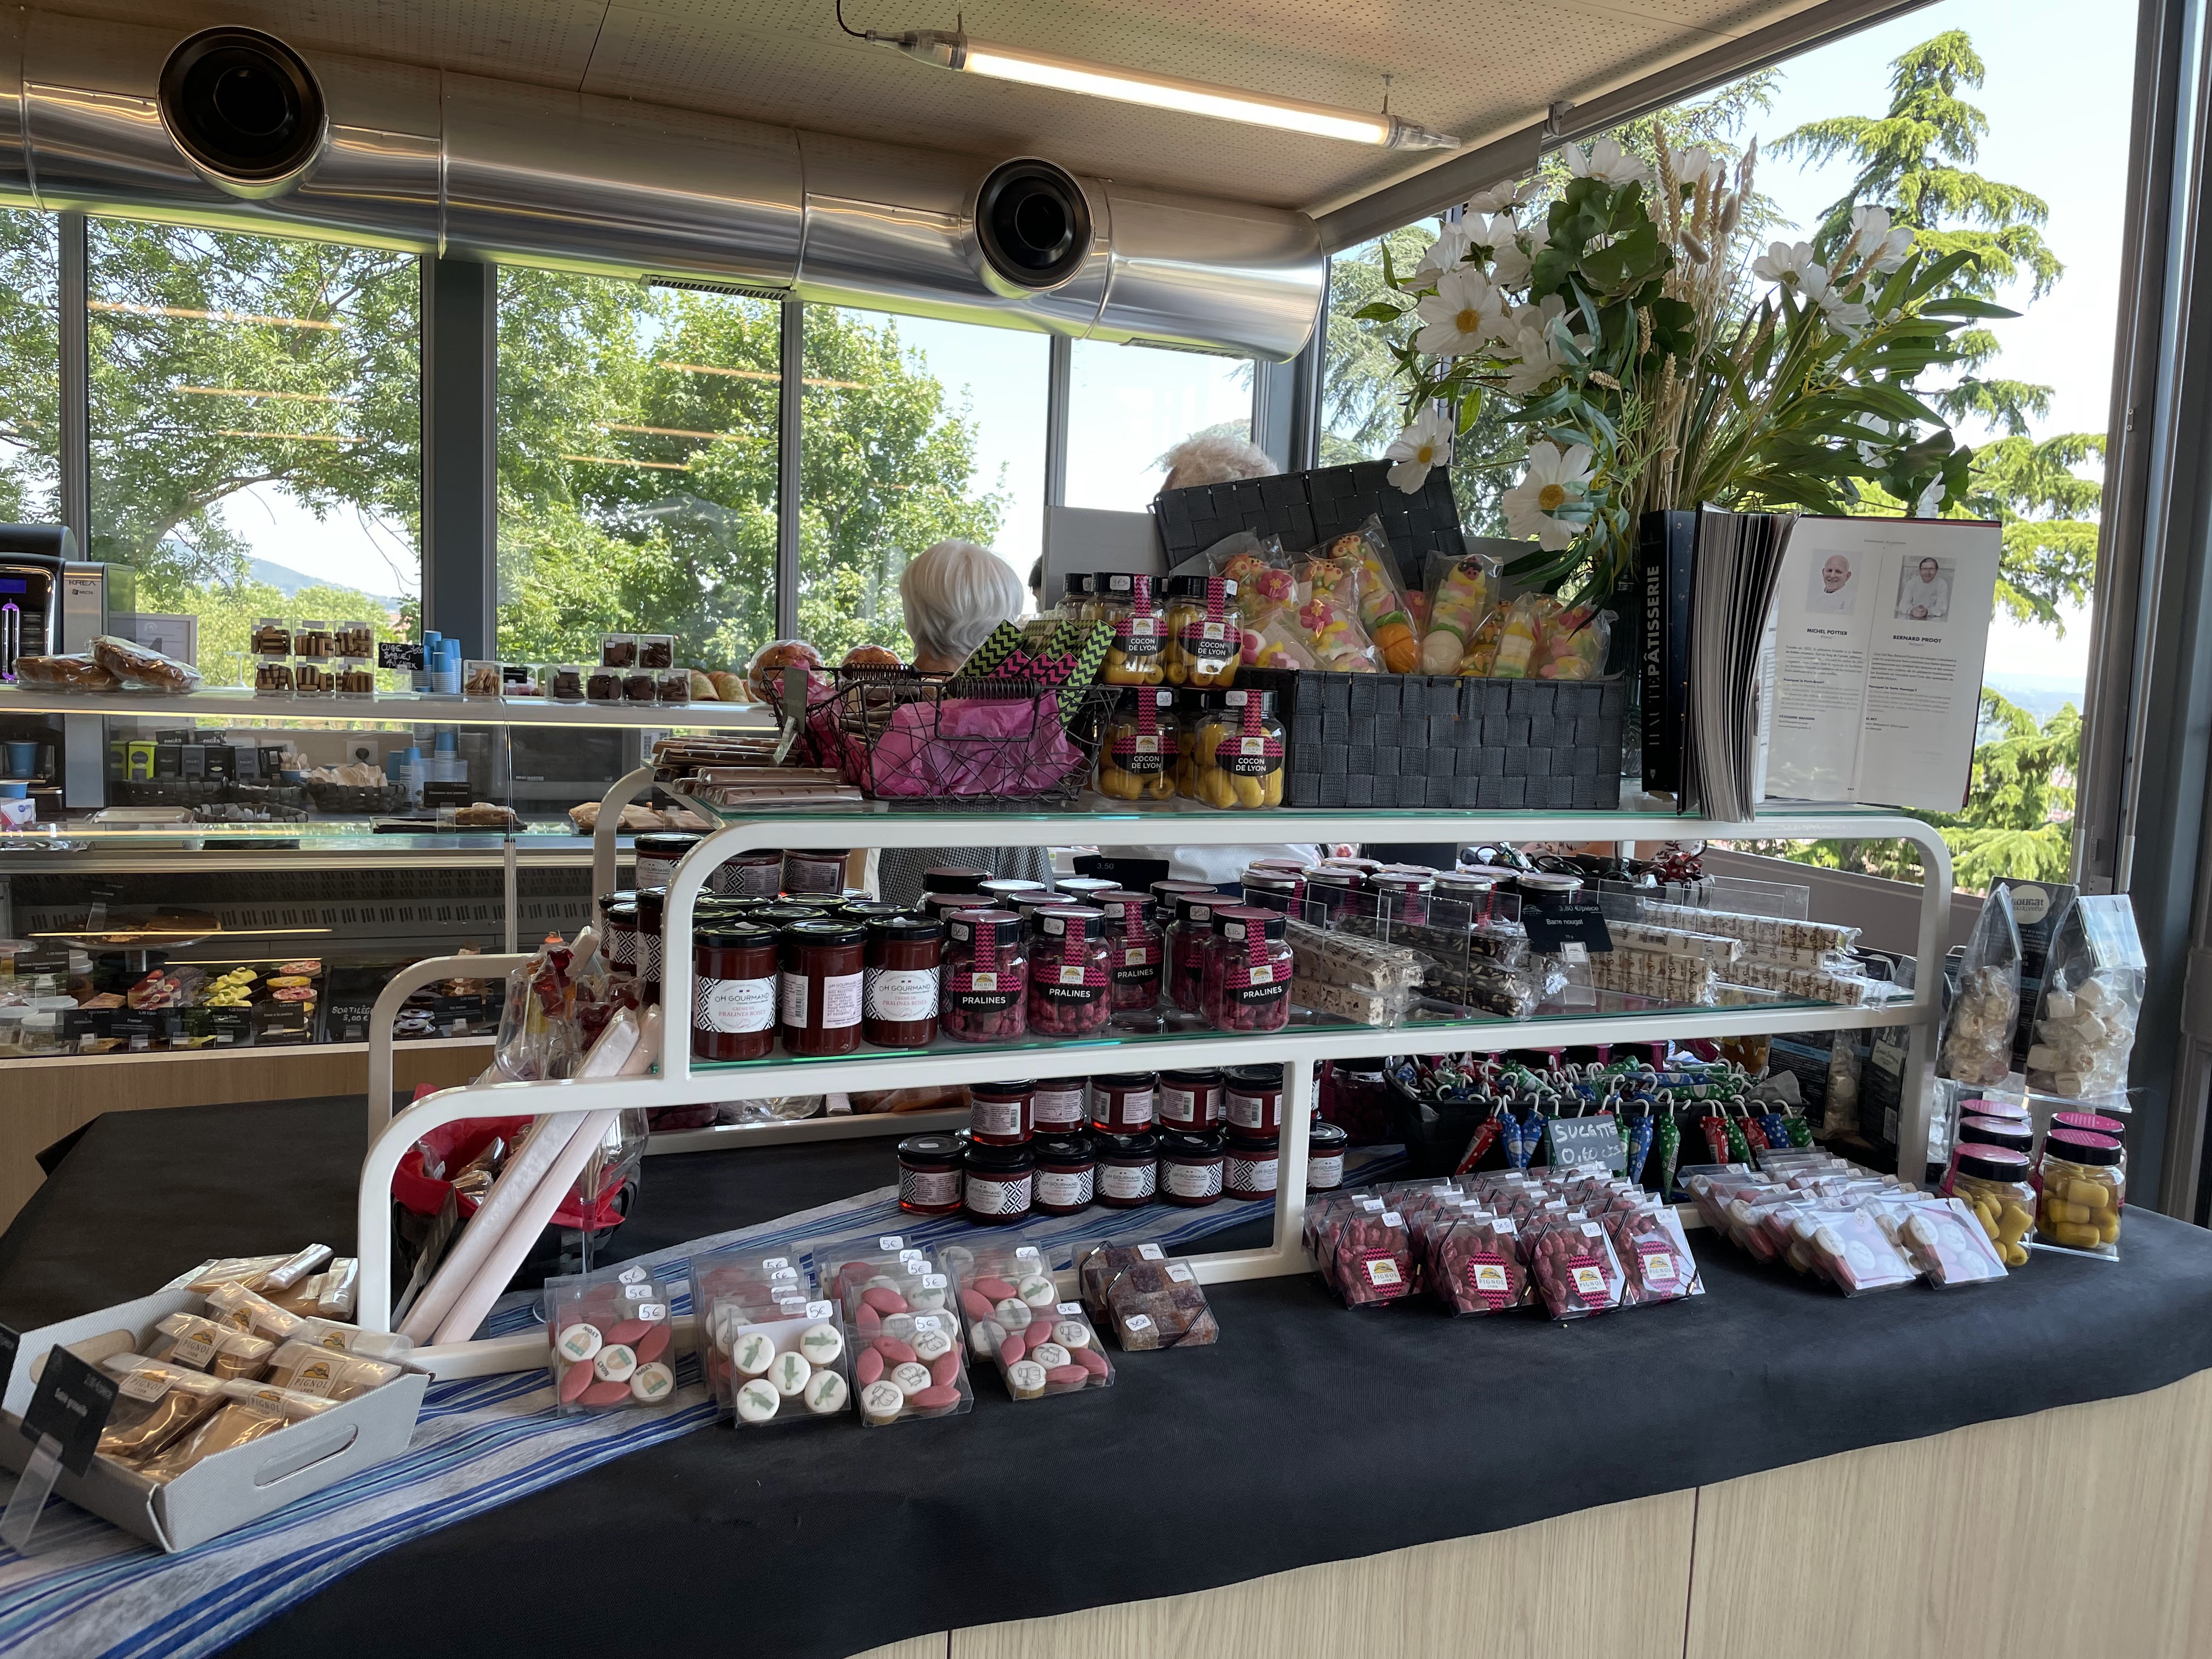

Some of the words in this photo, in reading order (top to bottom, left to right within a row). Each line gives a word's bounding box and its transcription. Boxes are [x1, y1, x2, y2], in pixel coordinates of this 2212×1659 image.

[1643, 566, 1660, 676] PÂTISSERIE
[1118, 968, 1154, 978] PRALINES
[729, 992, 769, 1002] GOURMAND
[1049, 989, 1091, 998] PRALINES
[1243, 985, 1283, 999] PRALINES
[962, 996, 1006, 1005] PRALINES
[1384, 1216, 1401, 1224] 3€50
[883, 1239, 897, 1249] 5€
[911, 1265, 926, 1274] 5€
[624, 1271, 639, 1284] 5€
[925, 1278, 940, 1286] 5€
[629, 1289, 646, 1299] 5€
[640, 1306, 662, 1319] 5€
[809, 1305, 826, 1318] 5€
[917, 1319, 935, 1329] 5€
[583, 1325, 599, 1339] LYON
[182, 1339, 211, 1355] PIGNOL
[598, 1361, 611, 1377] LYON
[636, 1364, 653, 1376] LYON
[129, 1378, 162, 1392] PIGNOL
[294, 1378, 328, 1389] PIGNOL
[251, 1397, 280, 1413] PIGNOL
